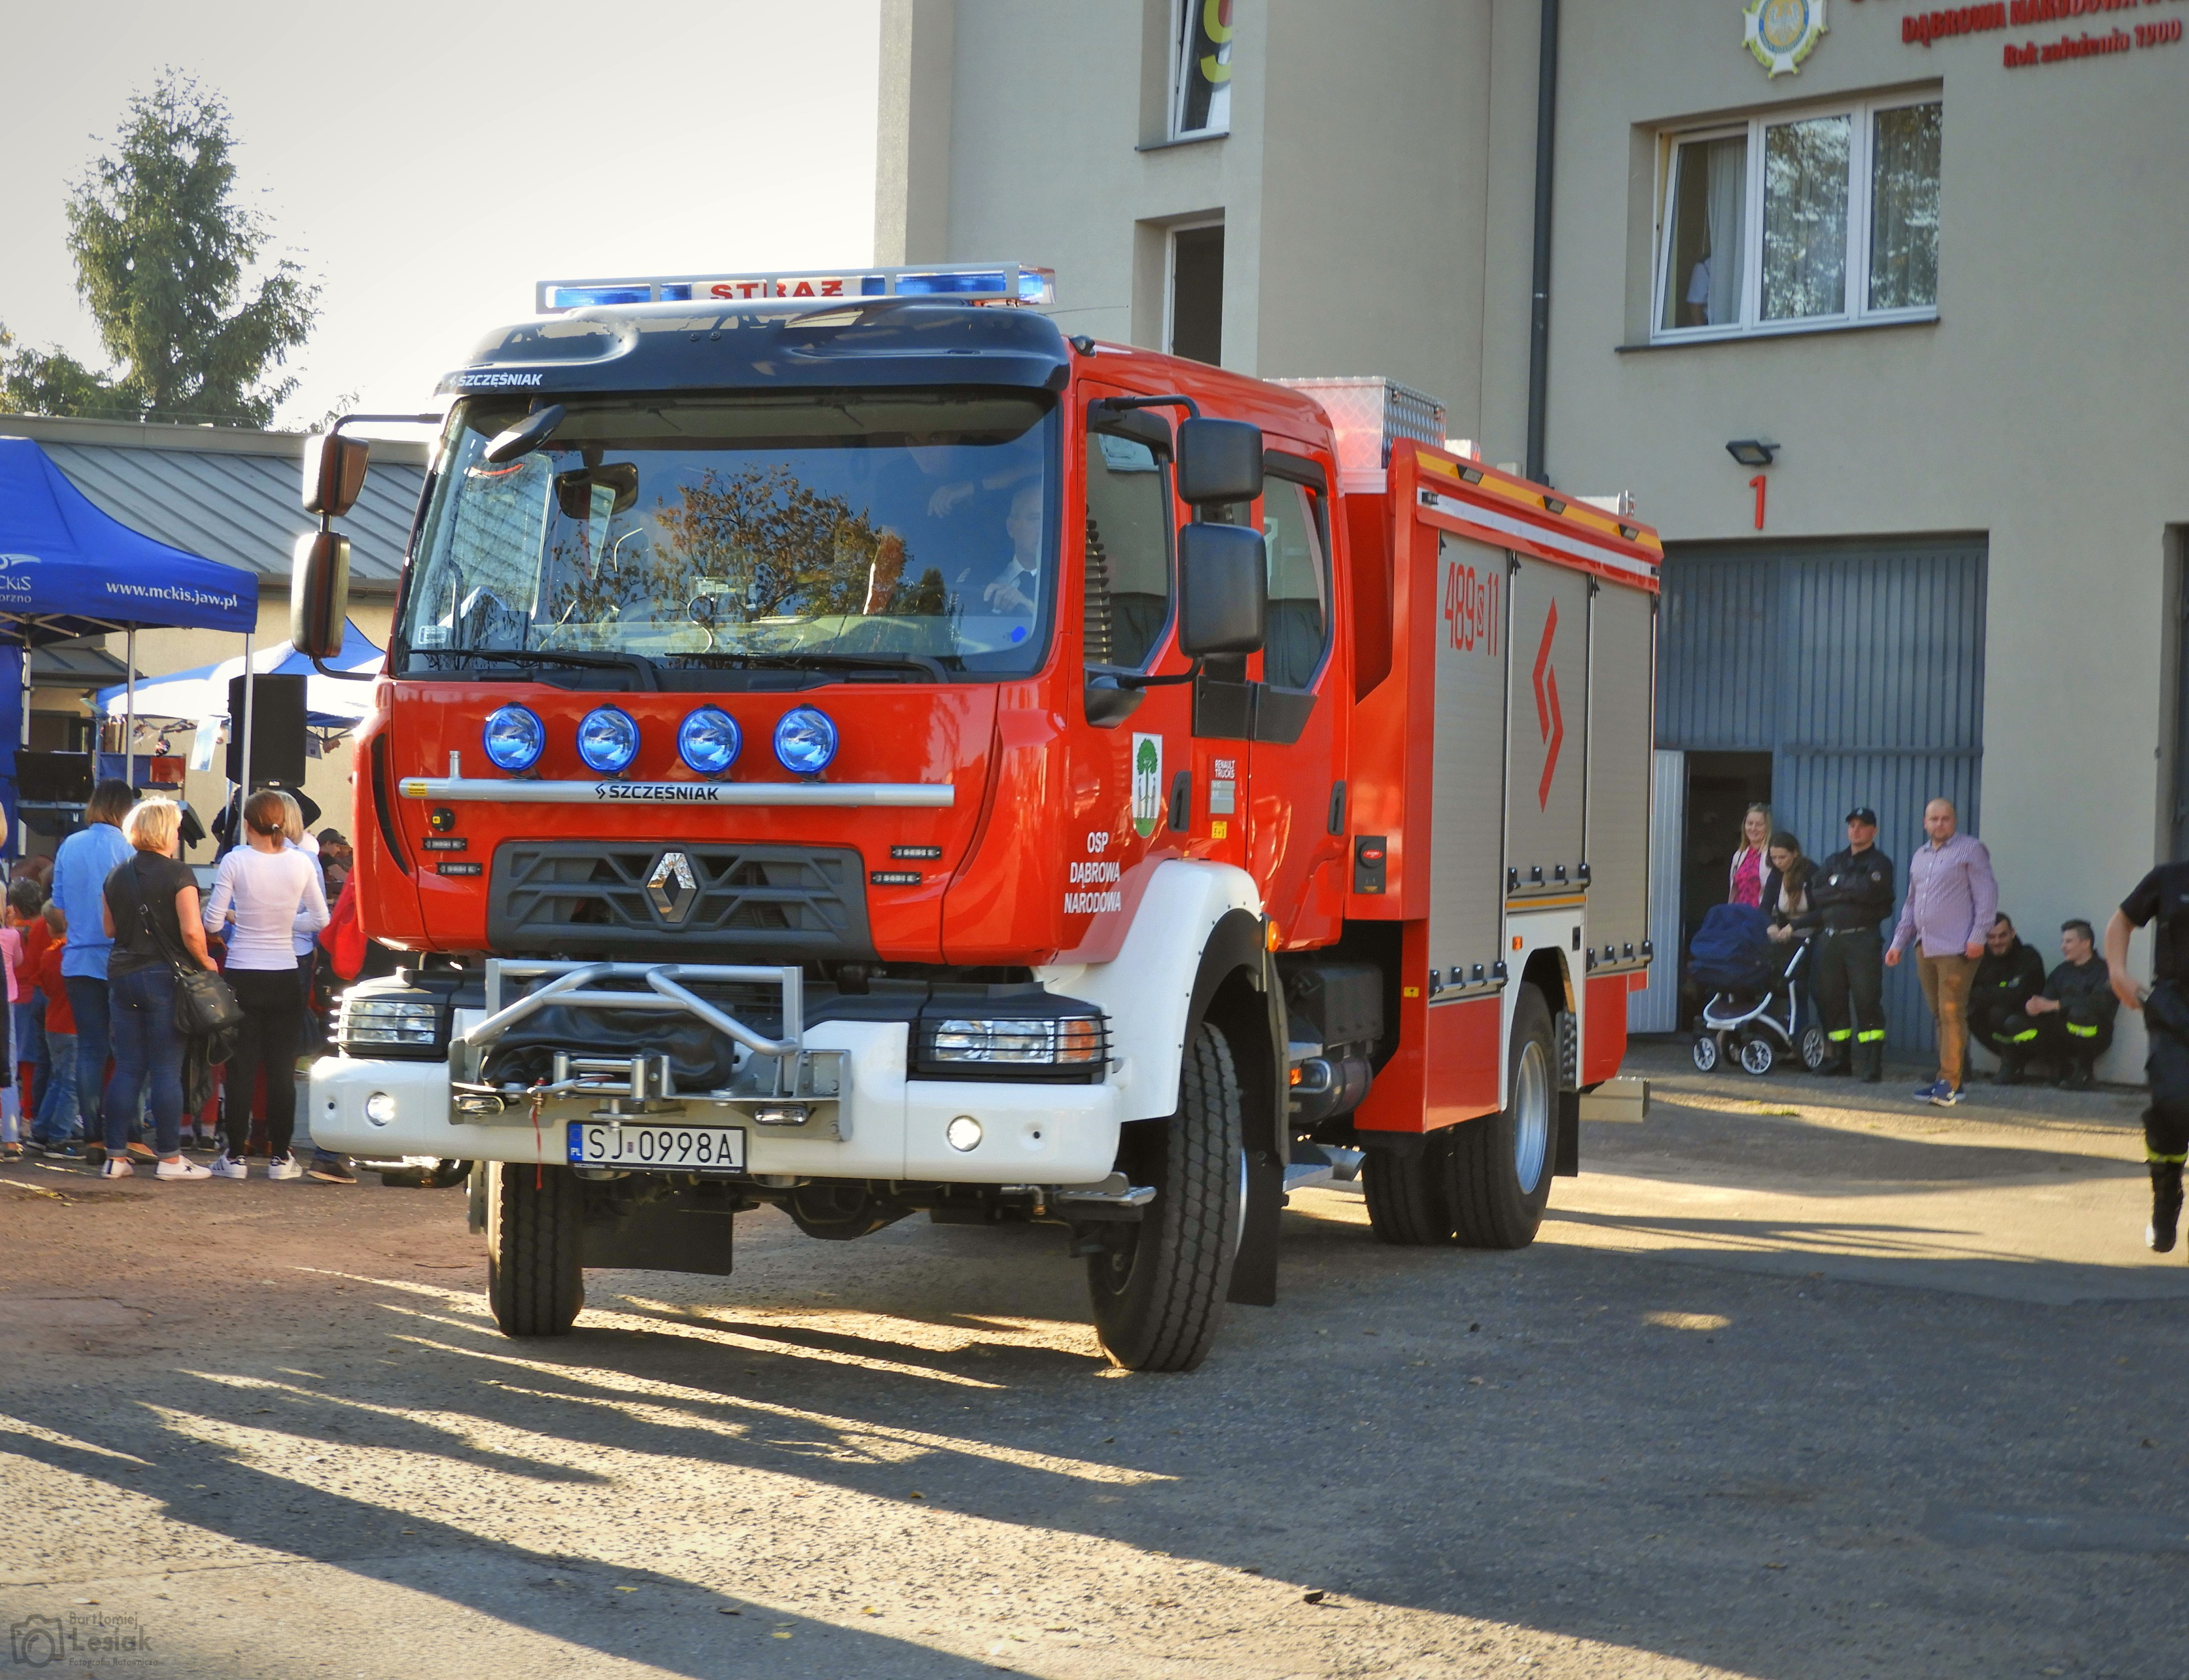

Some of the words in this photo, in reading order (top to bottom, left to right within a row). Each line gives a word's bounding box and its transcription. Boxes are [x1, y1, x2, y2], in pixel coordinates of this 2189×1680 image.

[1902, 2, 2006, 48] DĄBROWA
[2003, 41, 2038, 67] Rok
[2134, 18, 2181, 48] 1900
[458, 372, 543, 387] SZCZĘŚNIAK
[1749, 475, 1766, 529] 1
[106, 582, 238, 610] www.mckis.jaw.pl
[609, 785, 719, 801] SZCZĘŚNIAK
[1087, 832, 1109, 853] OSP
[1070, 862, 1120, 889] DĄBROWA
[1064, 892, 1121, 913] NARODOWA
[571, 1147, 582, 1156] PL
[640, 1131, 733, 1164] 0998A
